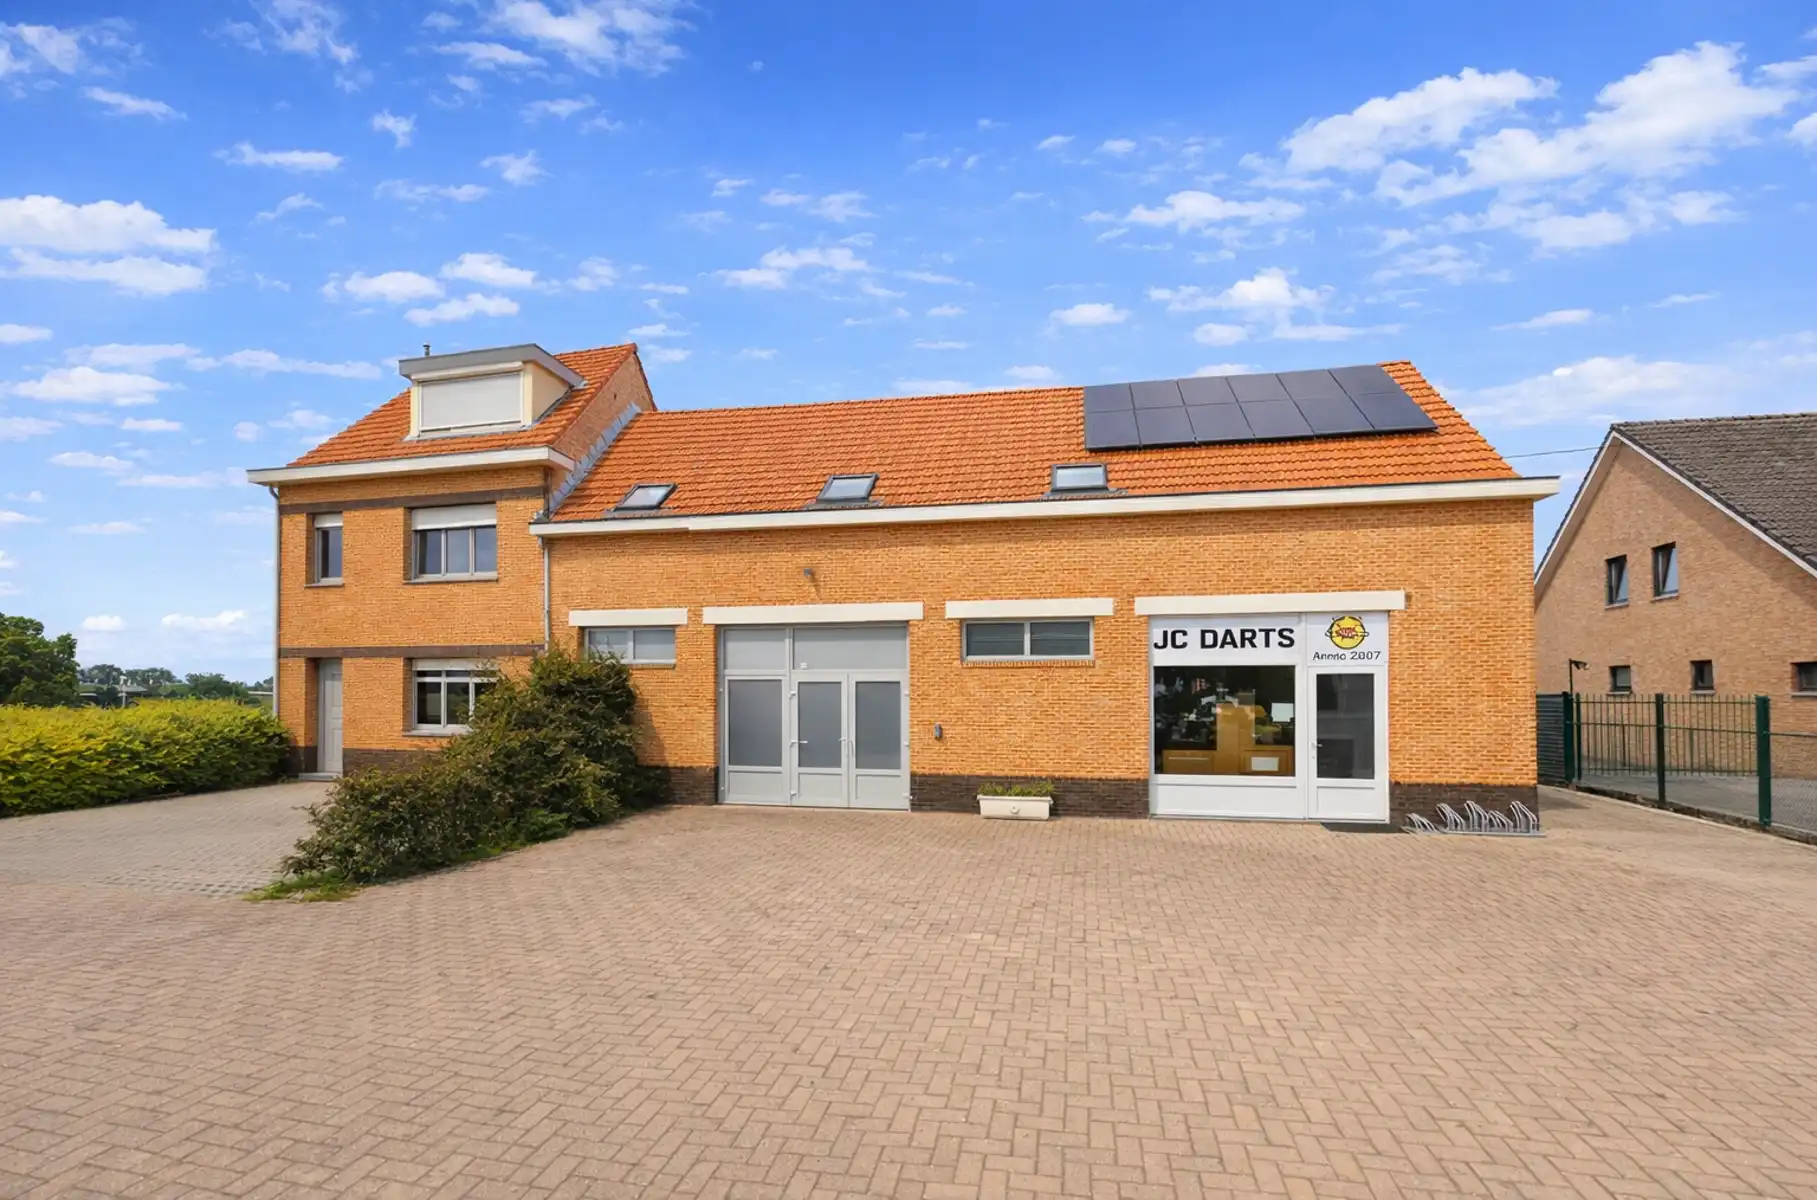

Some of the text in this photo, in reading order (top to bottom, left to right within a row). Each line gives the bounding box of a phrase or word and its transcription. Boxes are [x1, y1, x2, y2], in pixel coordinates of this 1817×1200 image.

[1153, 628, 1295, 650] JC DARTS
[1312, 650, 1381, 661] Anno 2007
